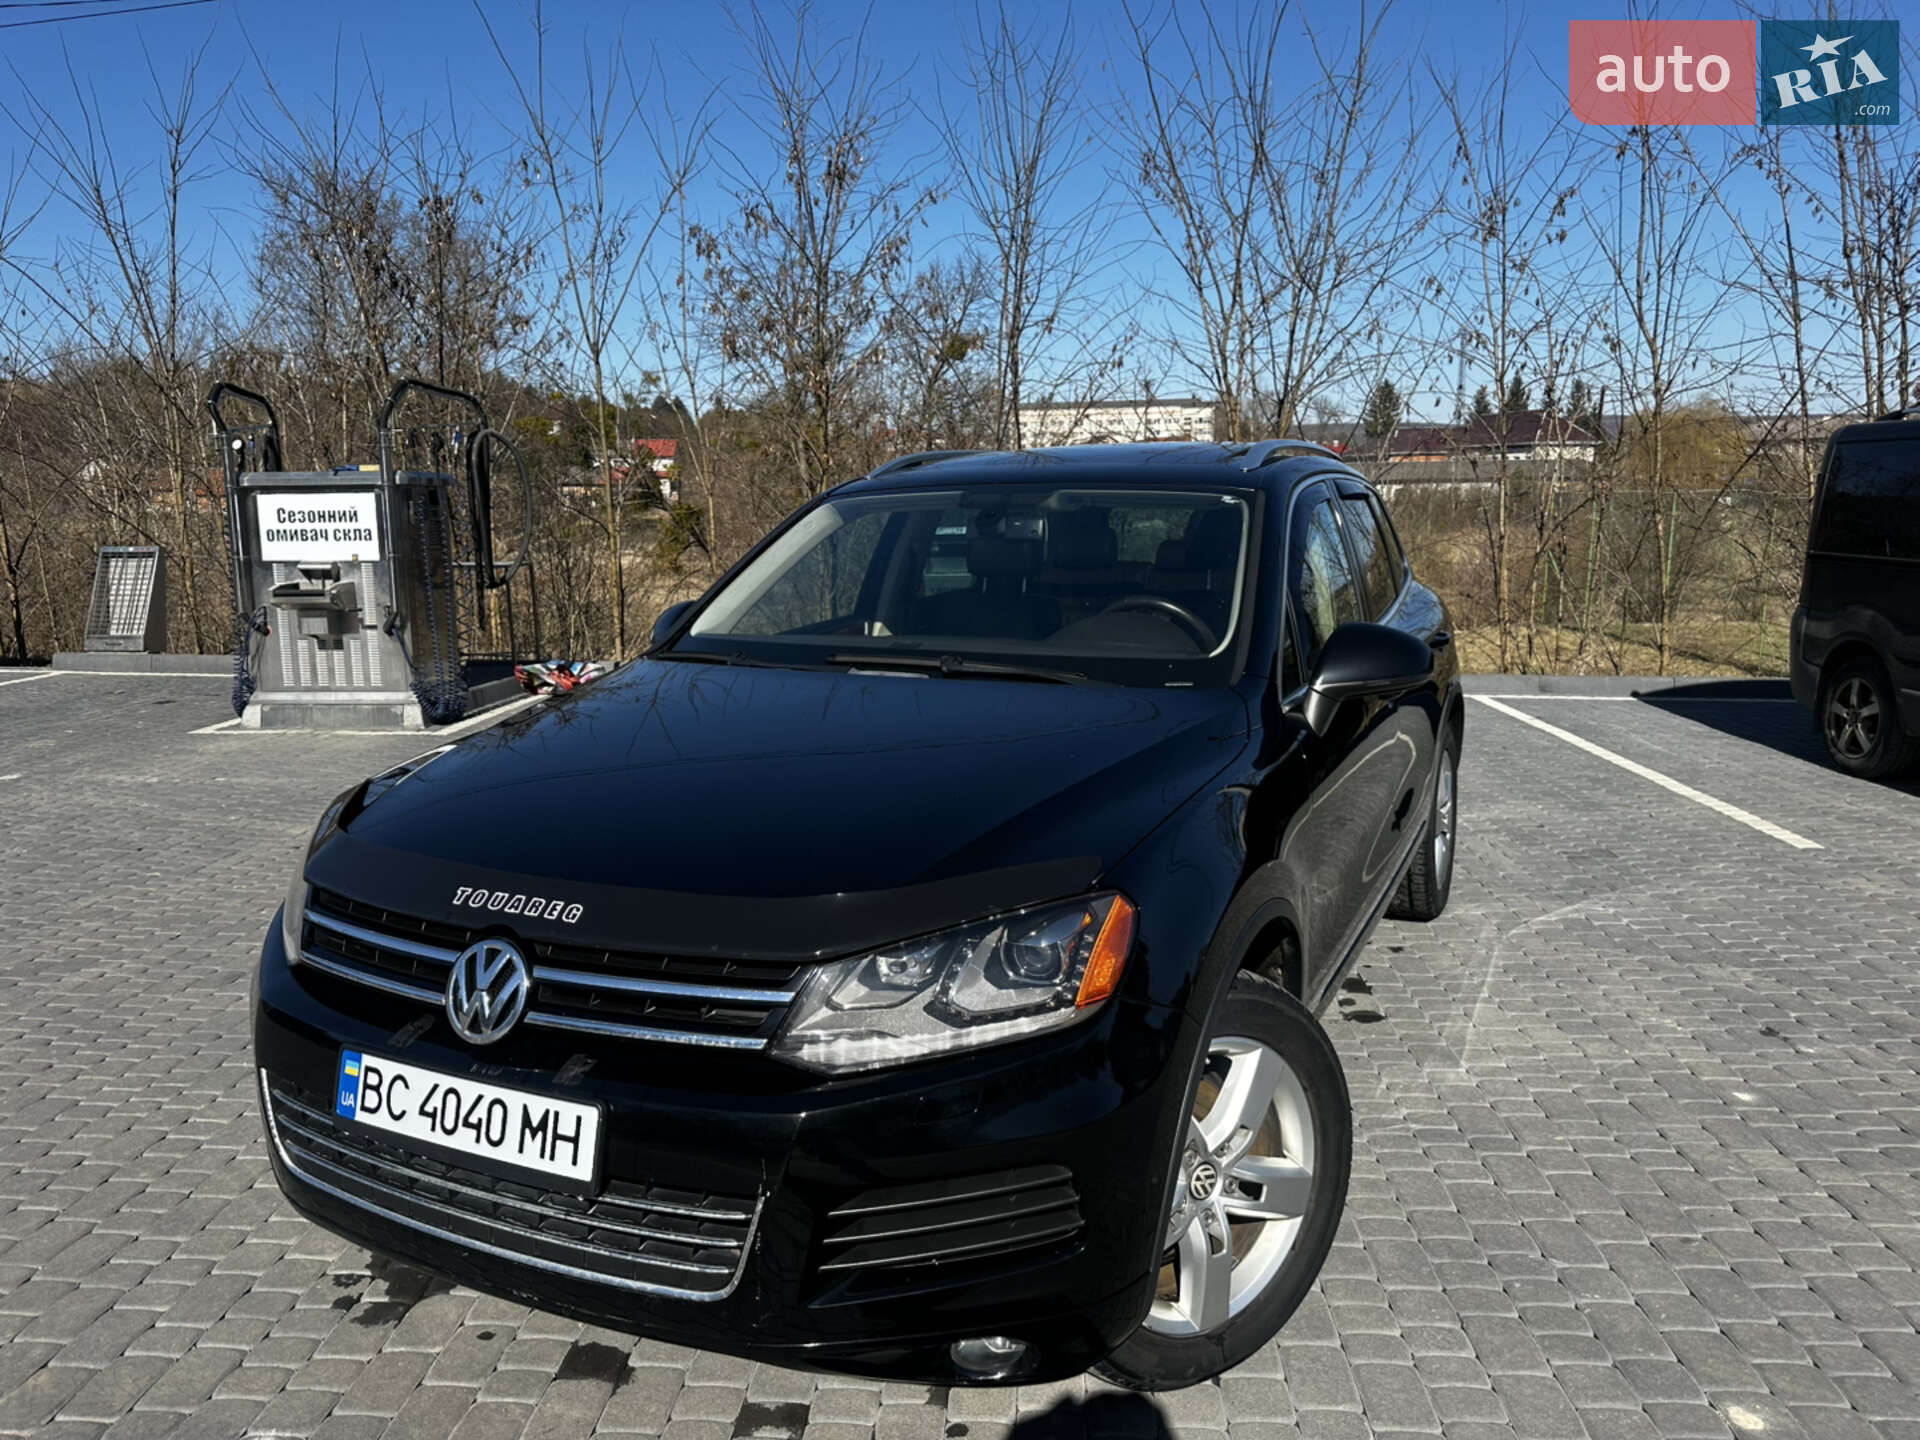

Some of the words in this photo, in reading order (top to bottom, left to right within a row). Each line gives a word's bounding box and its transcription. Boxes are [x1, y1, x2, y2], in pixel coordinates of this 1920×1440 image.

[276, 505, 359, 524] Сезонний
[266, 528, 329, 543] омивач
[333, 528, 373, 542] скла
[452, 886, 584, 924] TOUAREG
[447, 938, 529, 1044] VW
[340, 1090, 356, 1108] UA
[359, 1064, 410, 1121] BC
[418, 1083, 508, 1148] 4040
[517, 1103, 582, 1167] MH
